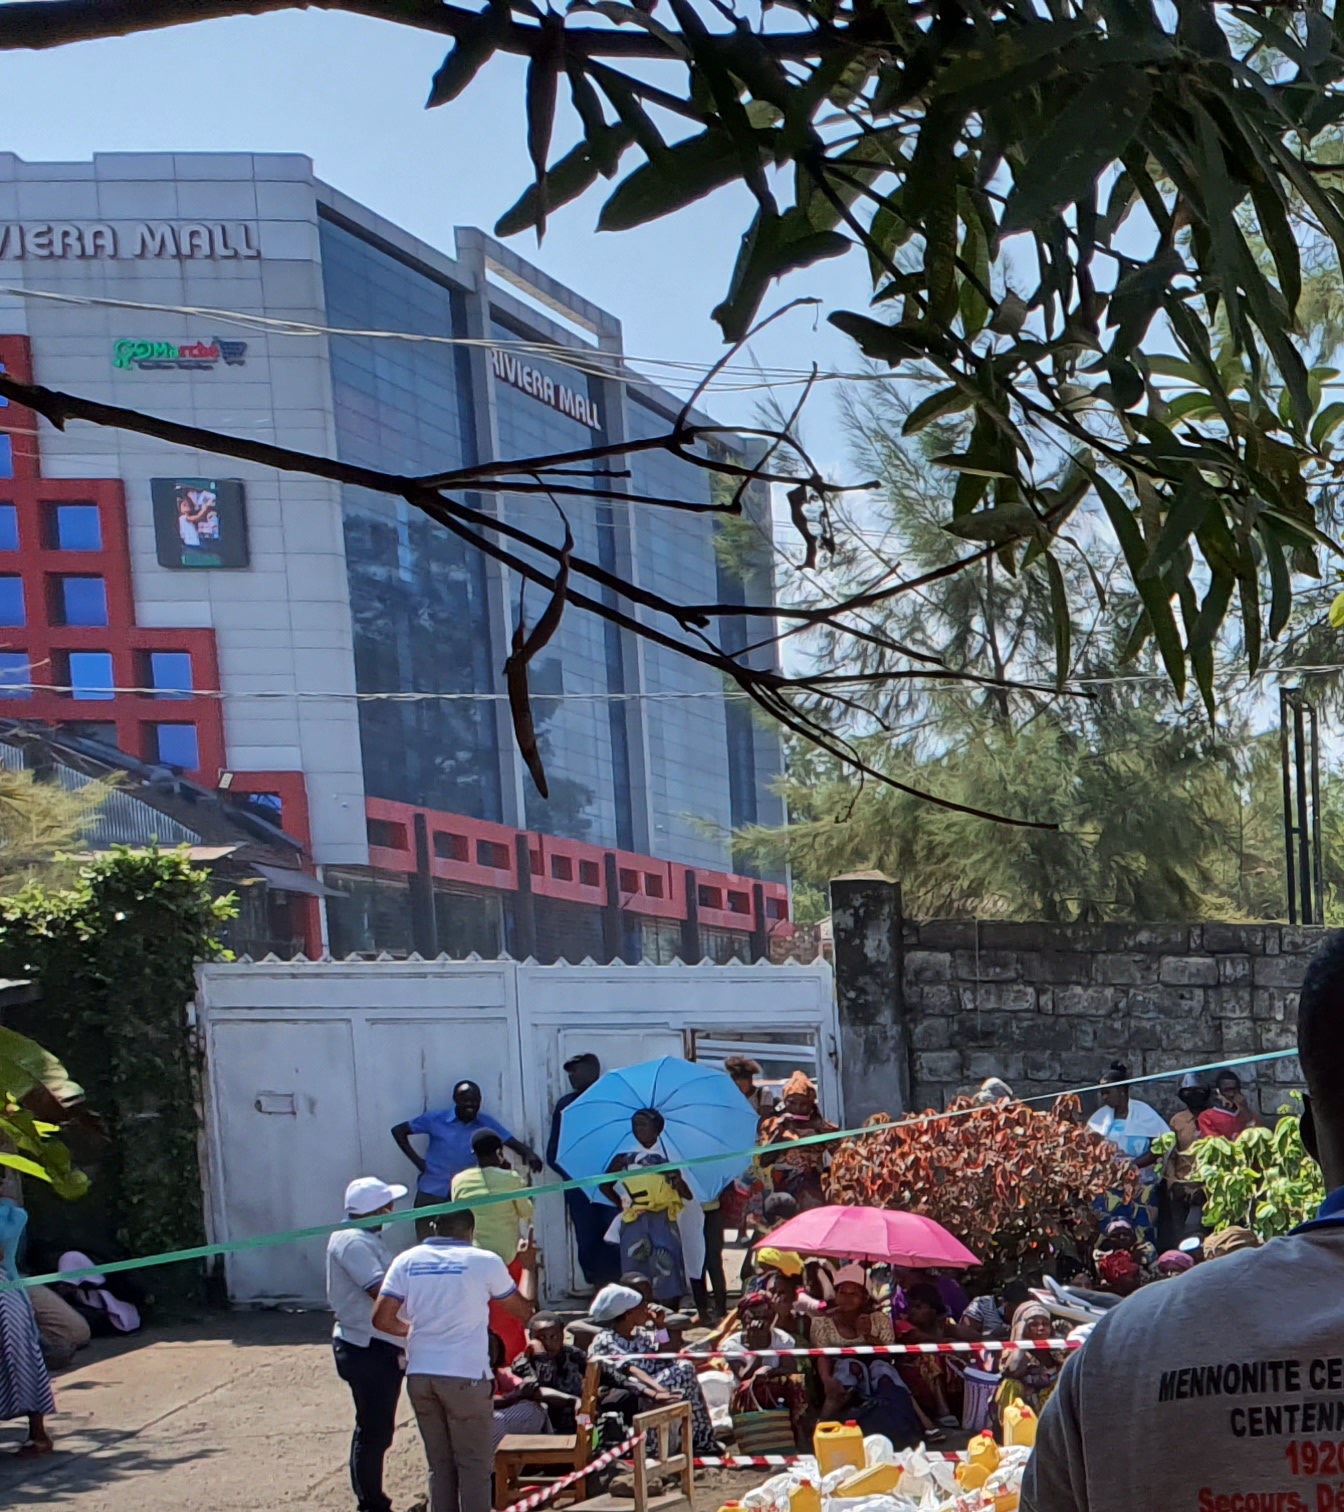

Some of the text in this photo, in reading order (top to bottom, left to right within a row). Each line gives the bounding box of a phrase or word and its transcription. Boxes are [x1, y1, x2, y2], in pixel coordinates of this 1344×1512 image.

[132, 223, 261, 259] MALL
[491, 347, 601, 431] RIVIERA MALL
[1159, 1359, 1300, 1402] MENNONITE
